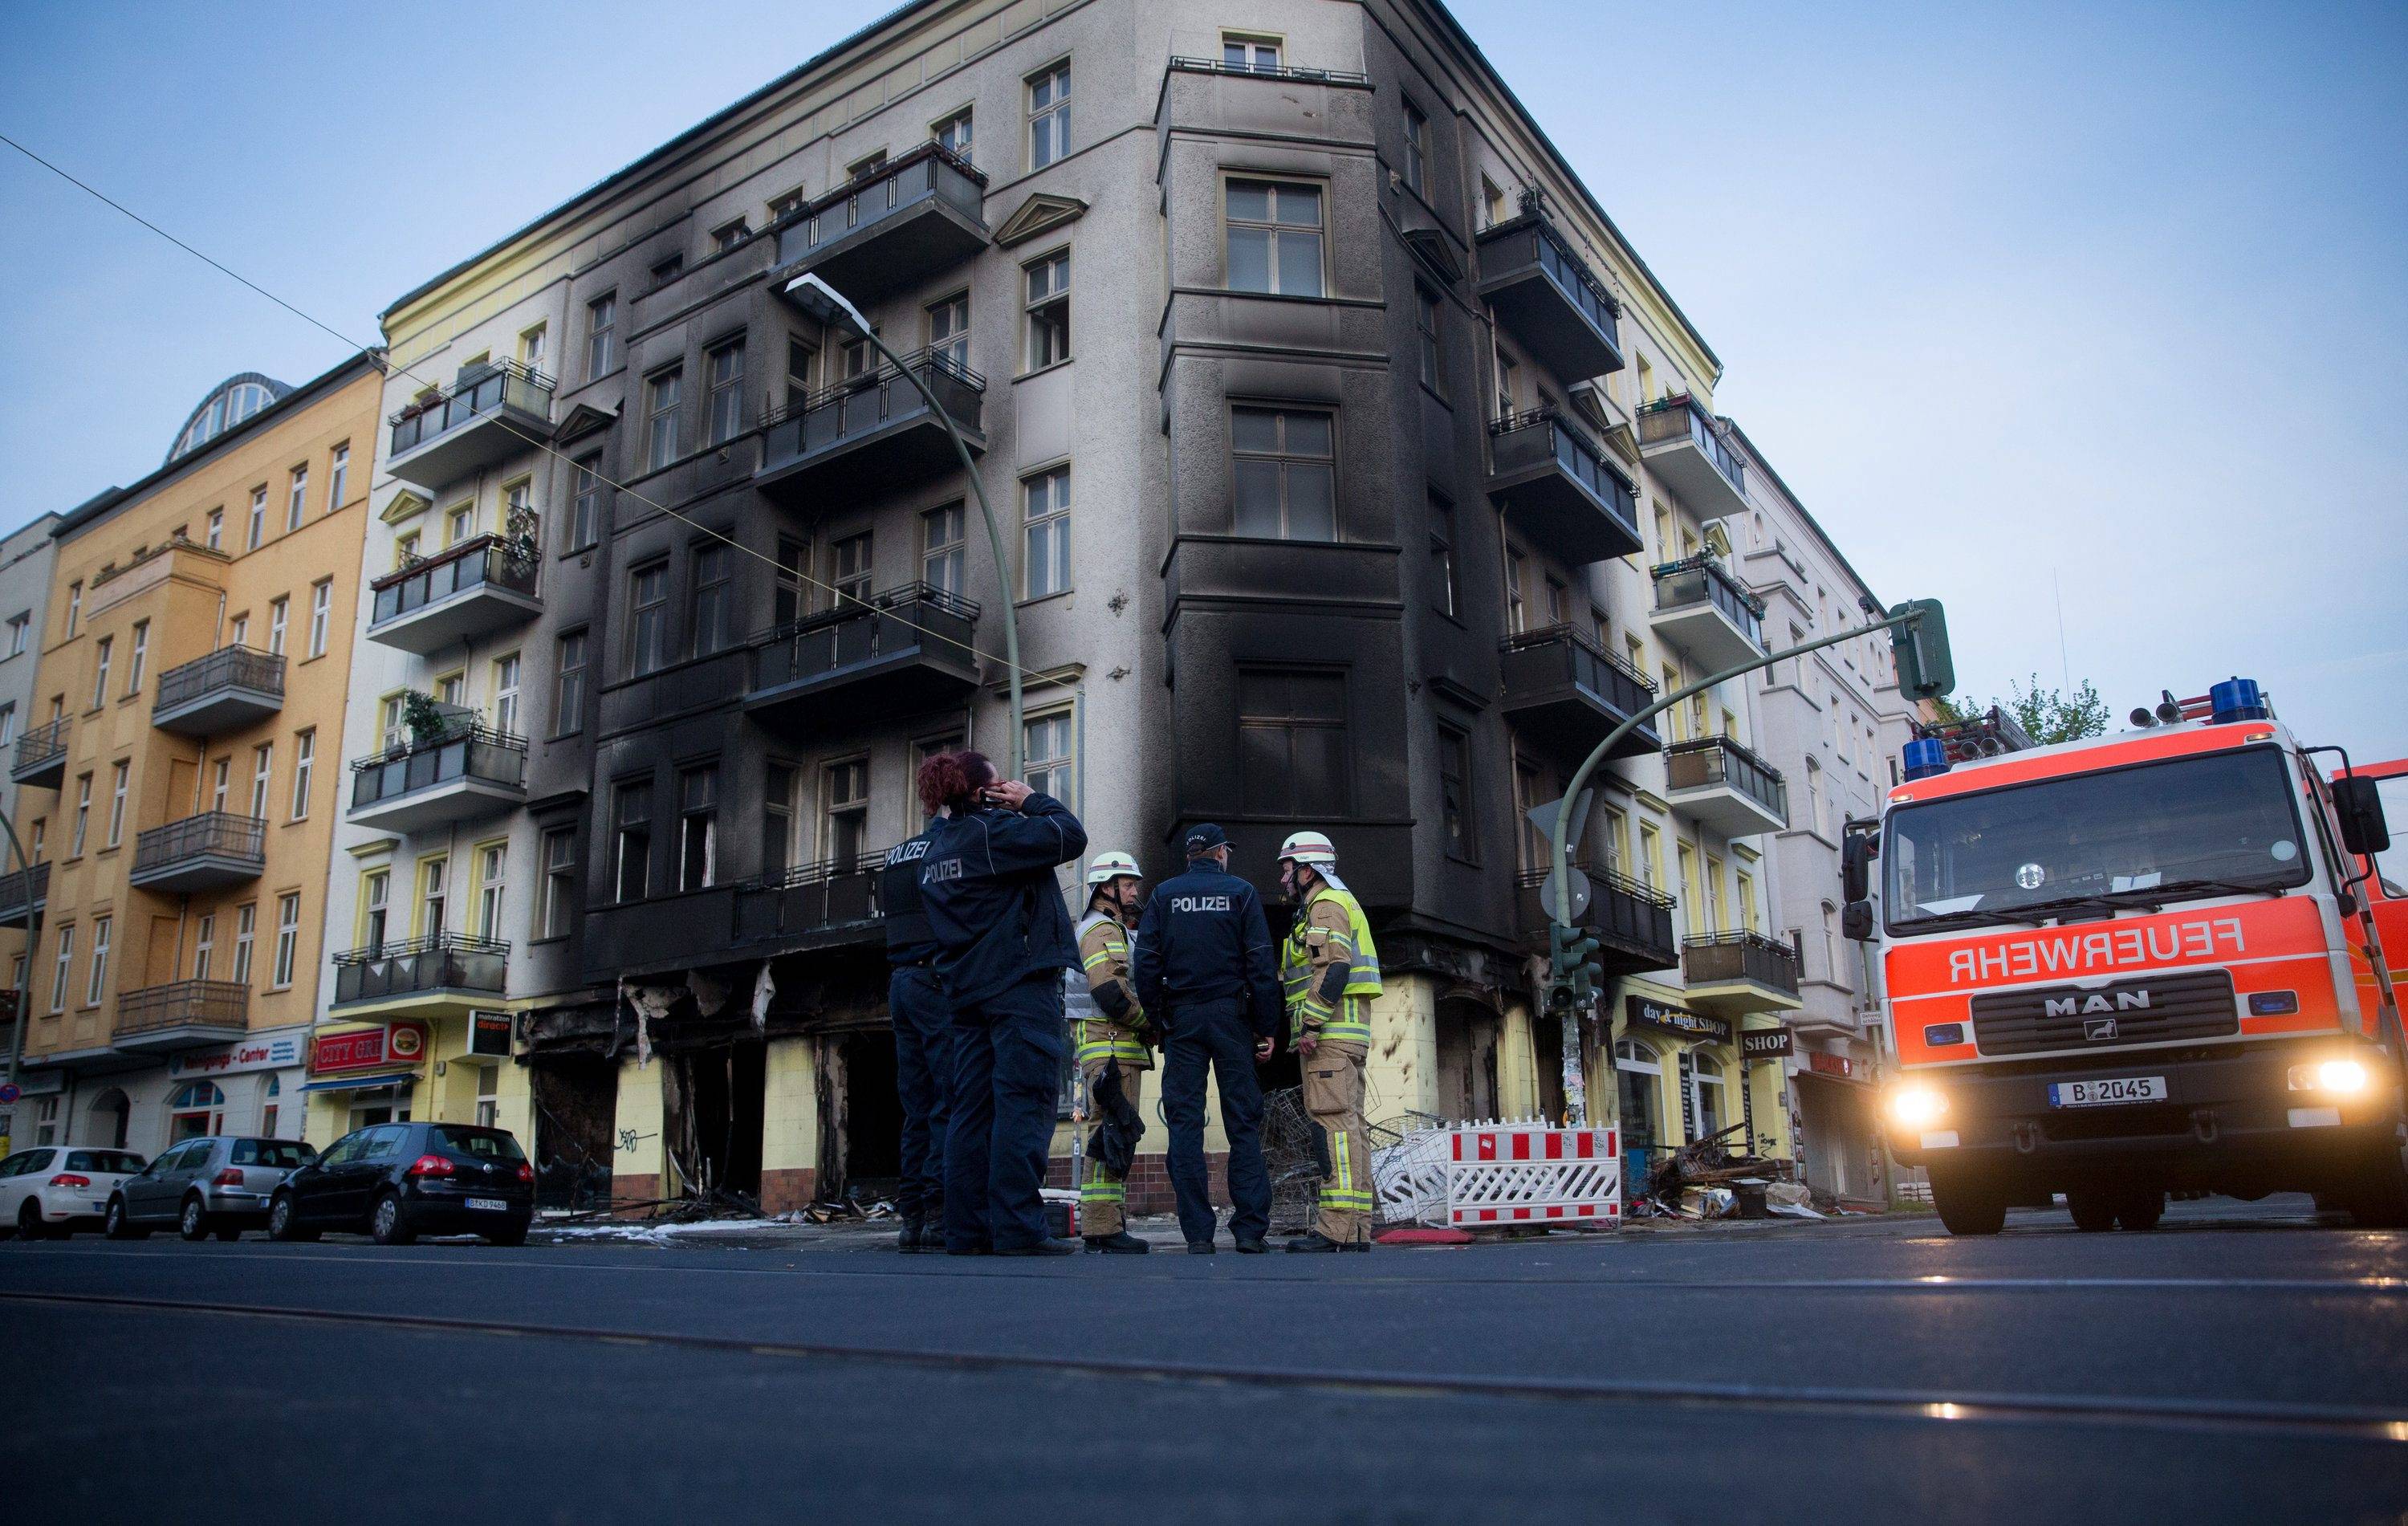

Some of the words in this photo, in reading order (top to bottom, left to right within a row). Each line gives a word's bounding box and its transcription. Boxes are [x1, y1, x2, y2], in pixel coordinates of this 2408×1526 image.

[885, 841, 930, 868] POLIZEI
[921, 858, 962, 885] POLIZEI
[1172, 896, 1230, 914] POLIZEI
[2045, 990, 2150, 1018] MAN
[477, 1020, 505, 1030] direct
[478, 1014, 510, 1022] matratzen
[1643, 1004, 1661, 1023] day
[1665, 1008, 1671, 1023] &
[1674, 1012, 1698, 1030] night
[1698, 1017, 1727, 1036] SHOP
[321, 1043, 350, 1063] CITY
[356, 1038, 384, 1059] GRI
[1745, 1035, 1788, 1052] SHOP
[238, 1047, 270, 1064] Center
[2072, 1084, 2086, 1101] B
[2098, 1080, 2151, 1099] 2045
